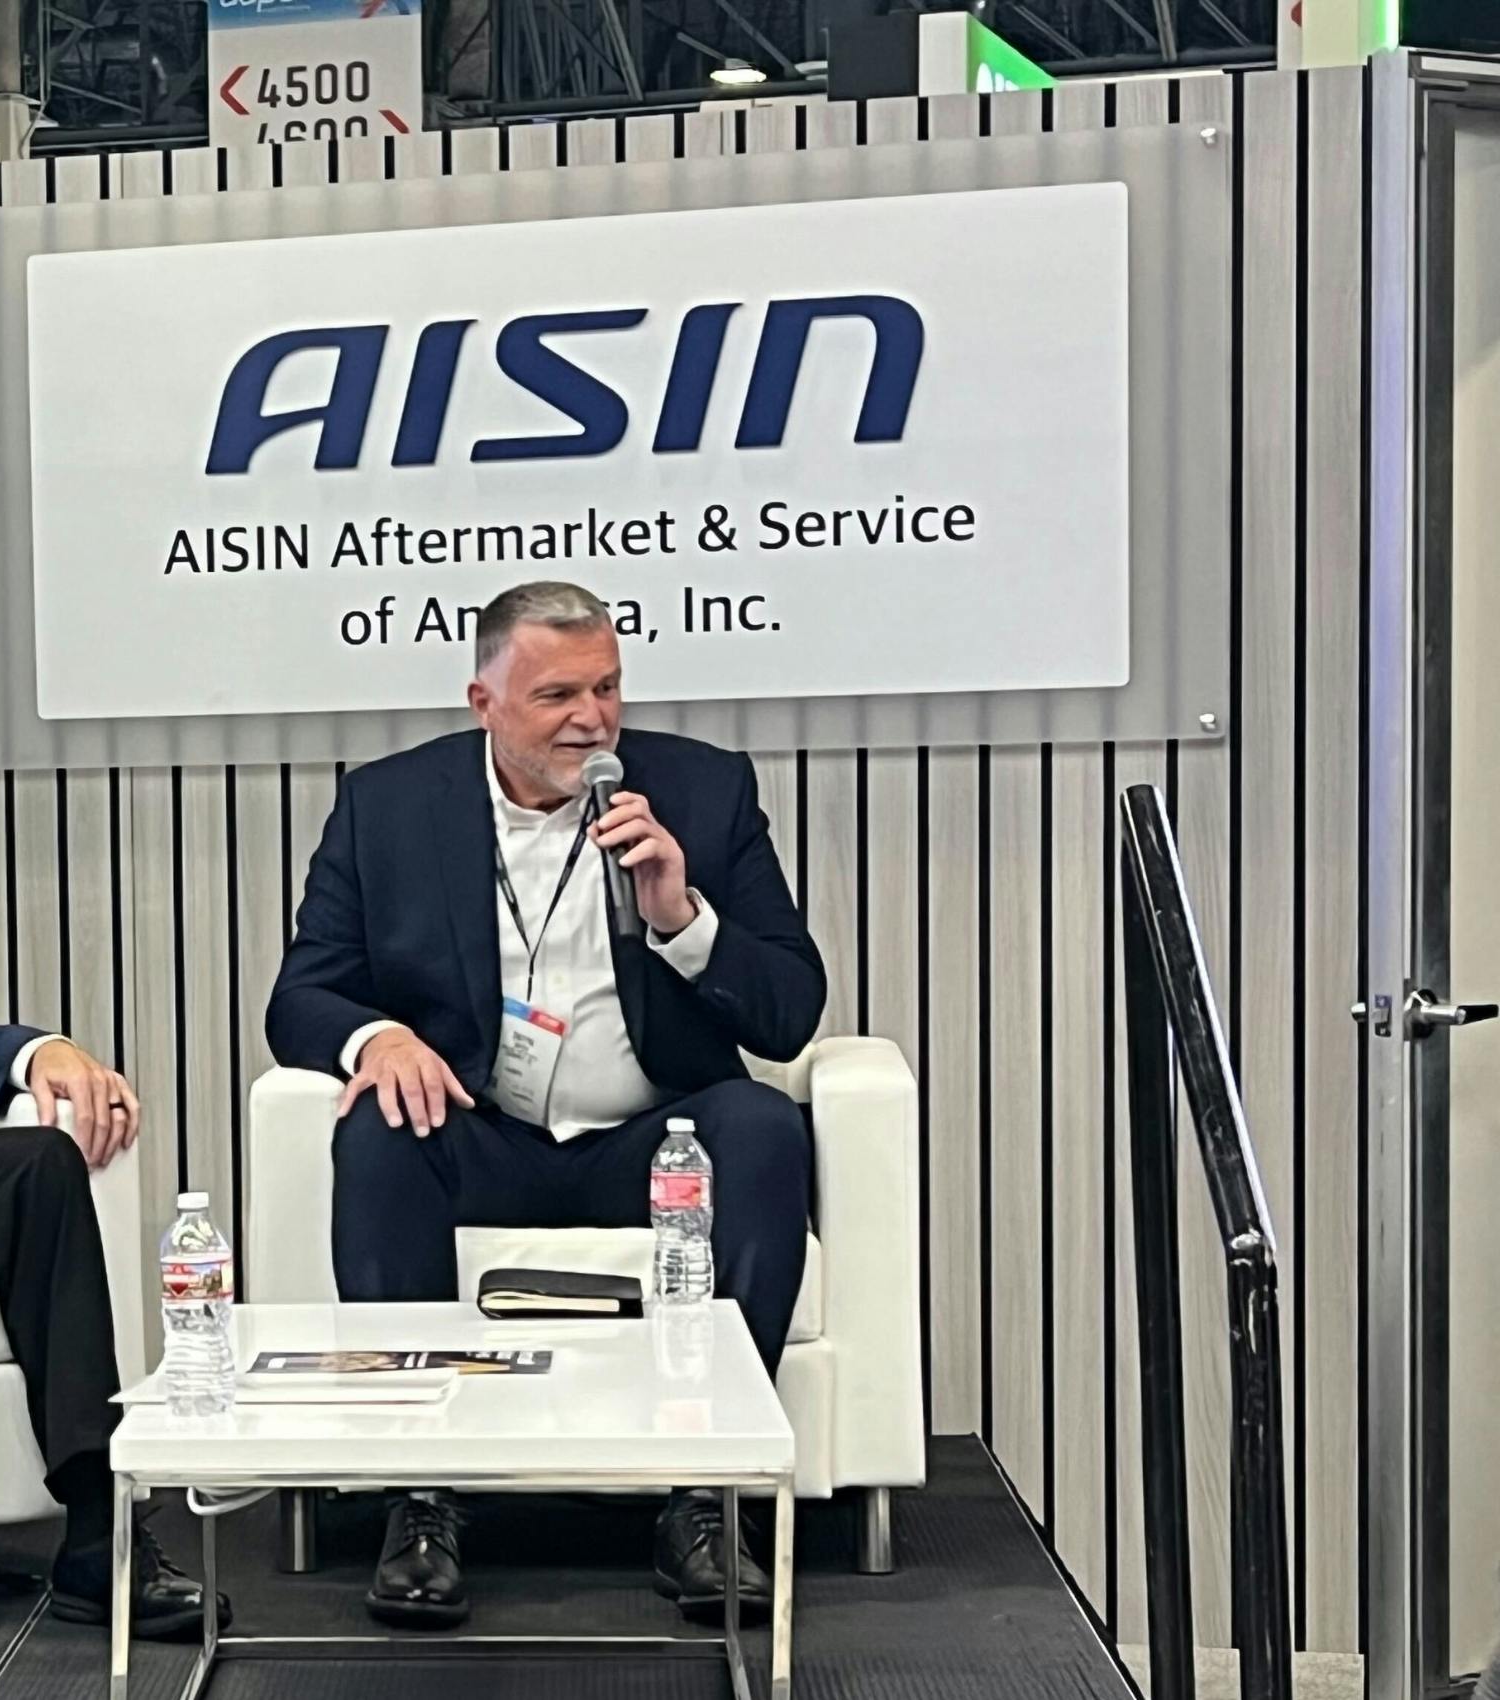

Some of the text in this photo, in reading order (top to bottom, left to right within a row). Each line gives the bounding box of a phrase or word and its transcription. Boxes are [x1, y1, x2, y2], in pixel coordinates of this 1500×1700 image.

[257, 61, 370, 109] 4500
[204, 294, 925, 476] AISIN
[163, 497, 975, 575] AISIN Aftermarket & Service
[341, 595, 396, 646] of
[684, 586, 782, 633] Inc.
